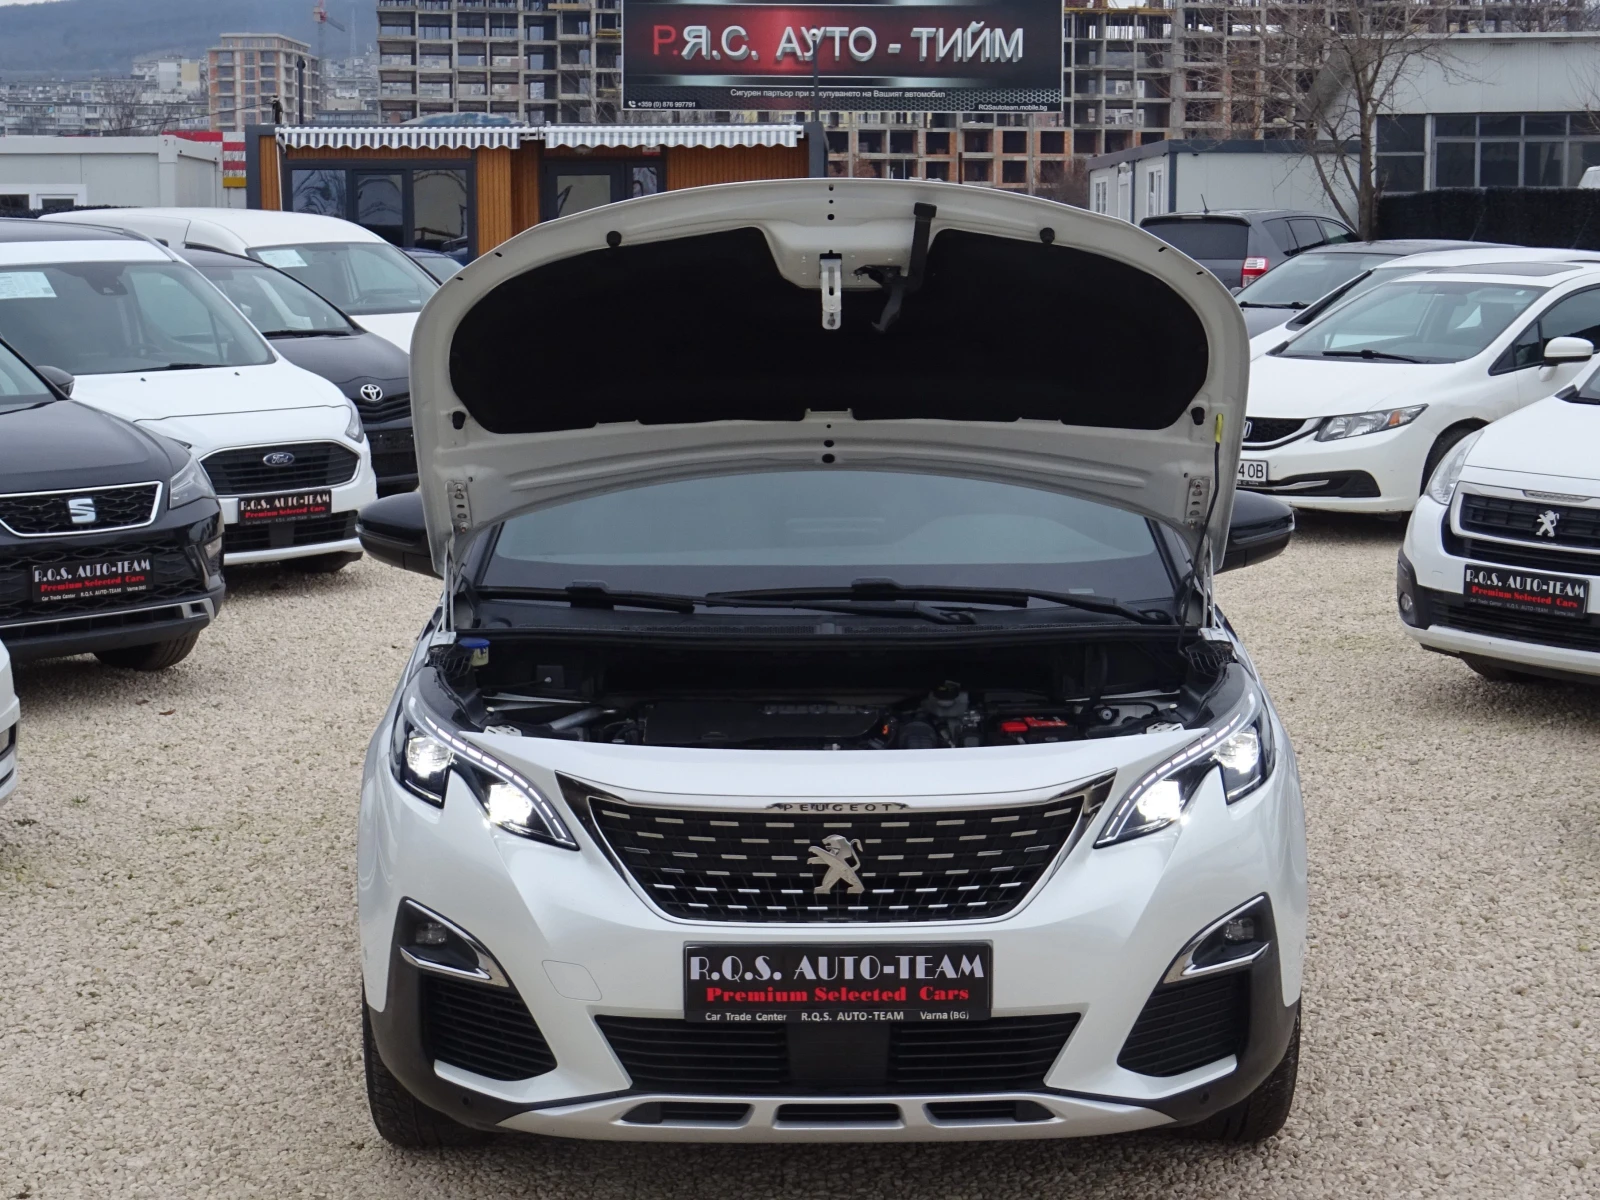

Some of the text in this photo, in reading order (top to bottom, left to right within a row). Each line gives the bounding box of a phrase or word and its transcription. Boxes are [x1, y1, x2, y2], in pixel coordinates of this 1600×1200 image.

[775, 26, 877, 62] АУТО
[910, 21, 1023, 62] ТИЙМ
[730, 89, 761, 97] Сигурен
[811, 90, 860, 98] зкупуването
[904, 90, 945, 98] автомобил
[273, 493, 330, 508] AUTO-TEAM
[76, 559, 150, 578] AUTO-TEAM
[41, 575, 145, 592] Premium Selected Cars
[1465, 569, 1585, 598] R.Q.S. AUTO-TEAM
[1471, 585, 1578, 608] Premium Selected Cars
[783, 803, 892, 812] PEUGEOT
[690, 954, 985, 982] R.Q.S. AUTO-TEAM
[706, 986, 969, 1002] Premium Selected Cars
[705, 1010, 970, 1022] Car Trade Center R.Q.S. AUTO-TEAM Varna (BG)
